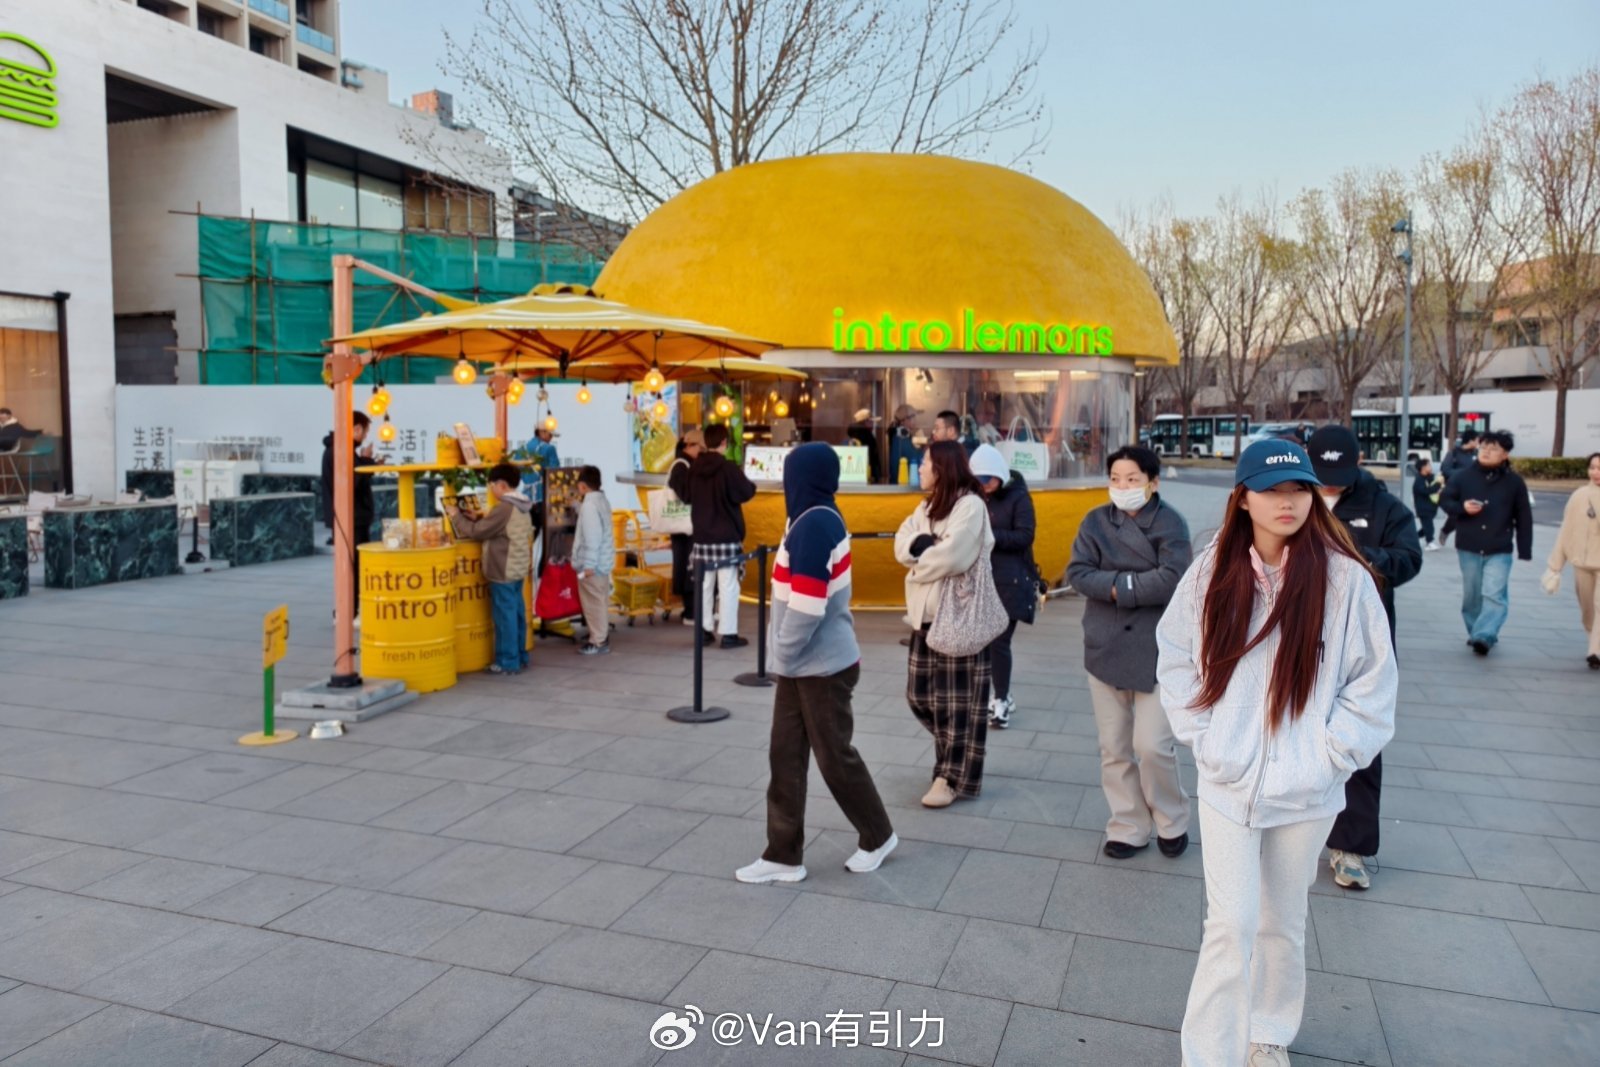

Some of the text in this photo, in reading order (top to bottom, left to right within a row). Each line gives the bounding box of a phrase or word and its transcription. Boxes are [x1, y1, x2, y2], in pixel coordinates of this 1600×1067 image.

[833, 307, 1113, 356] intro lemons
[133, 427, 165, 447] 生活
[134, 450, 165, 471] 元素
[1265, 451, 1300, 465] emis
[365, 568, 423, 592] intro
[376, 594, 437, 620] intro
[382, 650, 416, 662] fresh
